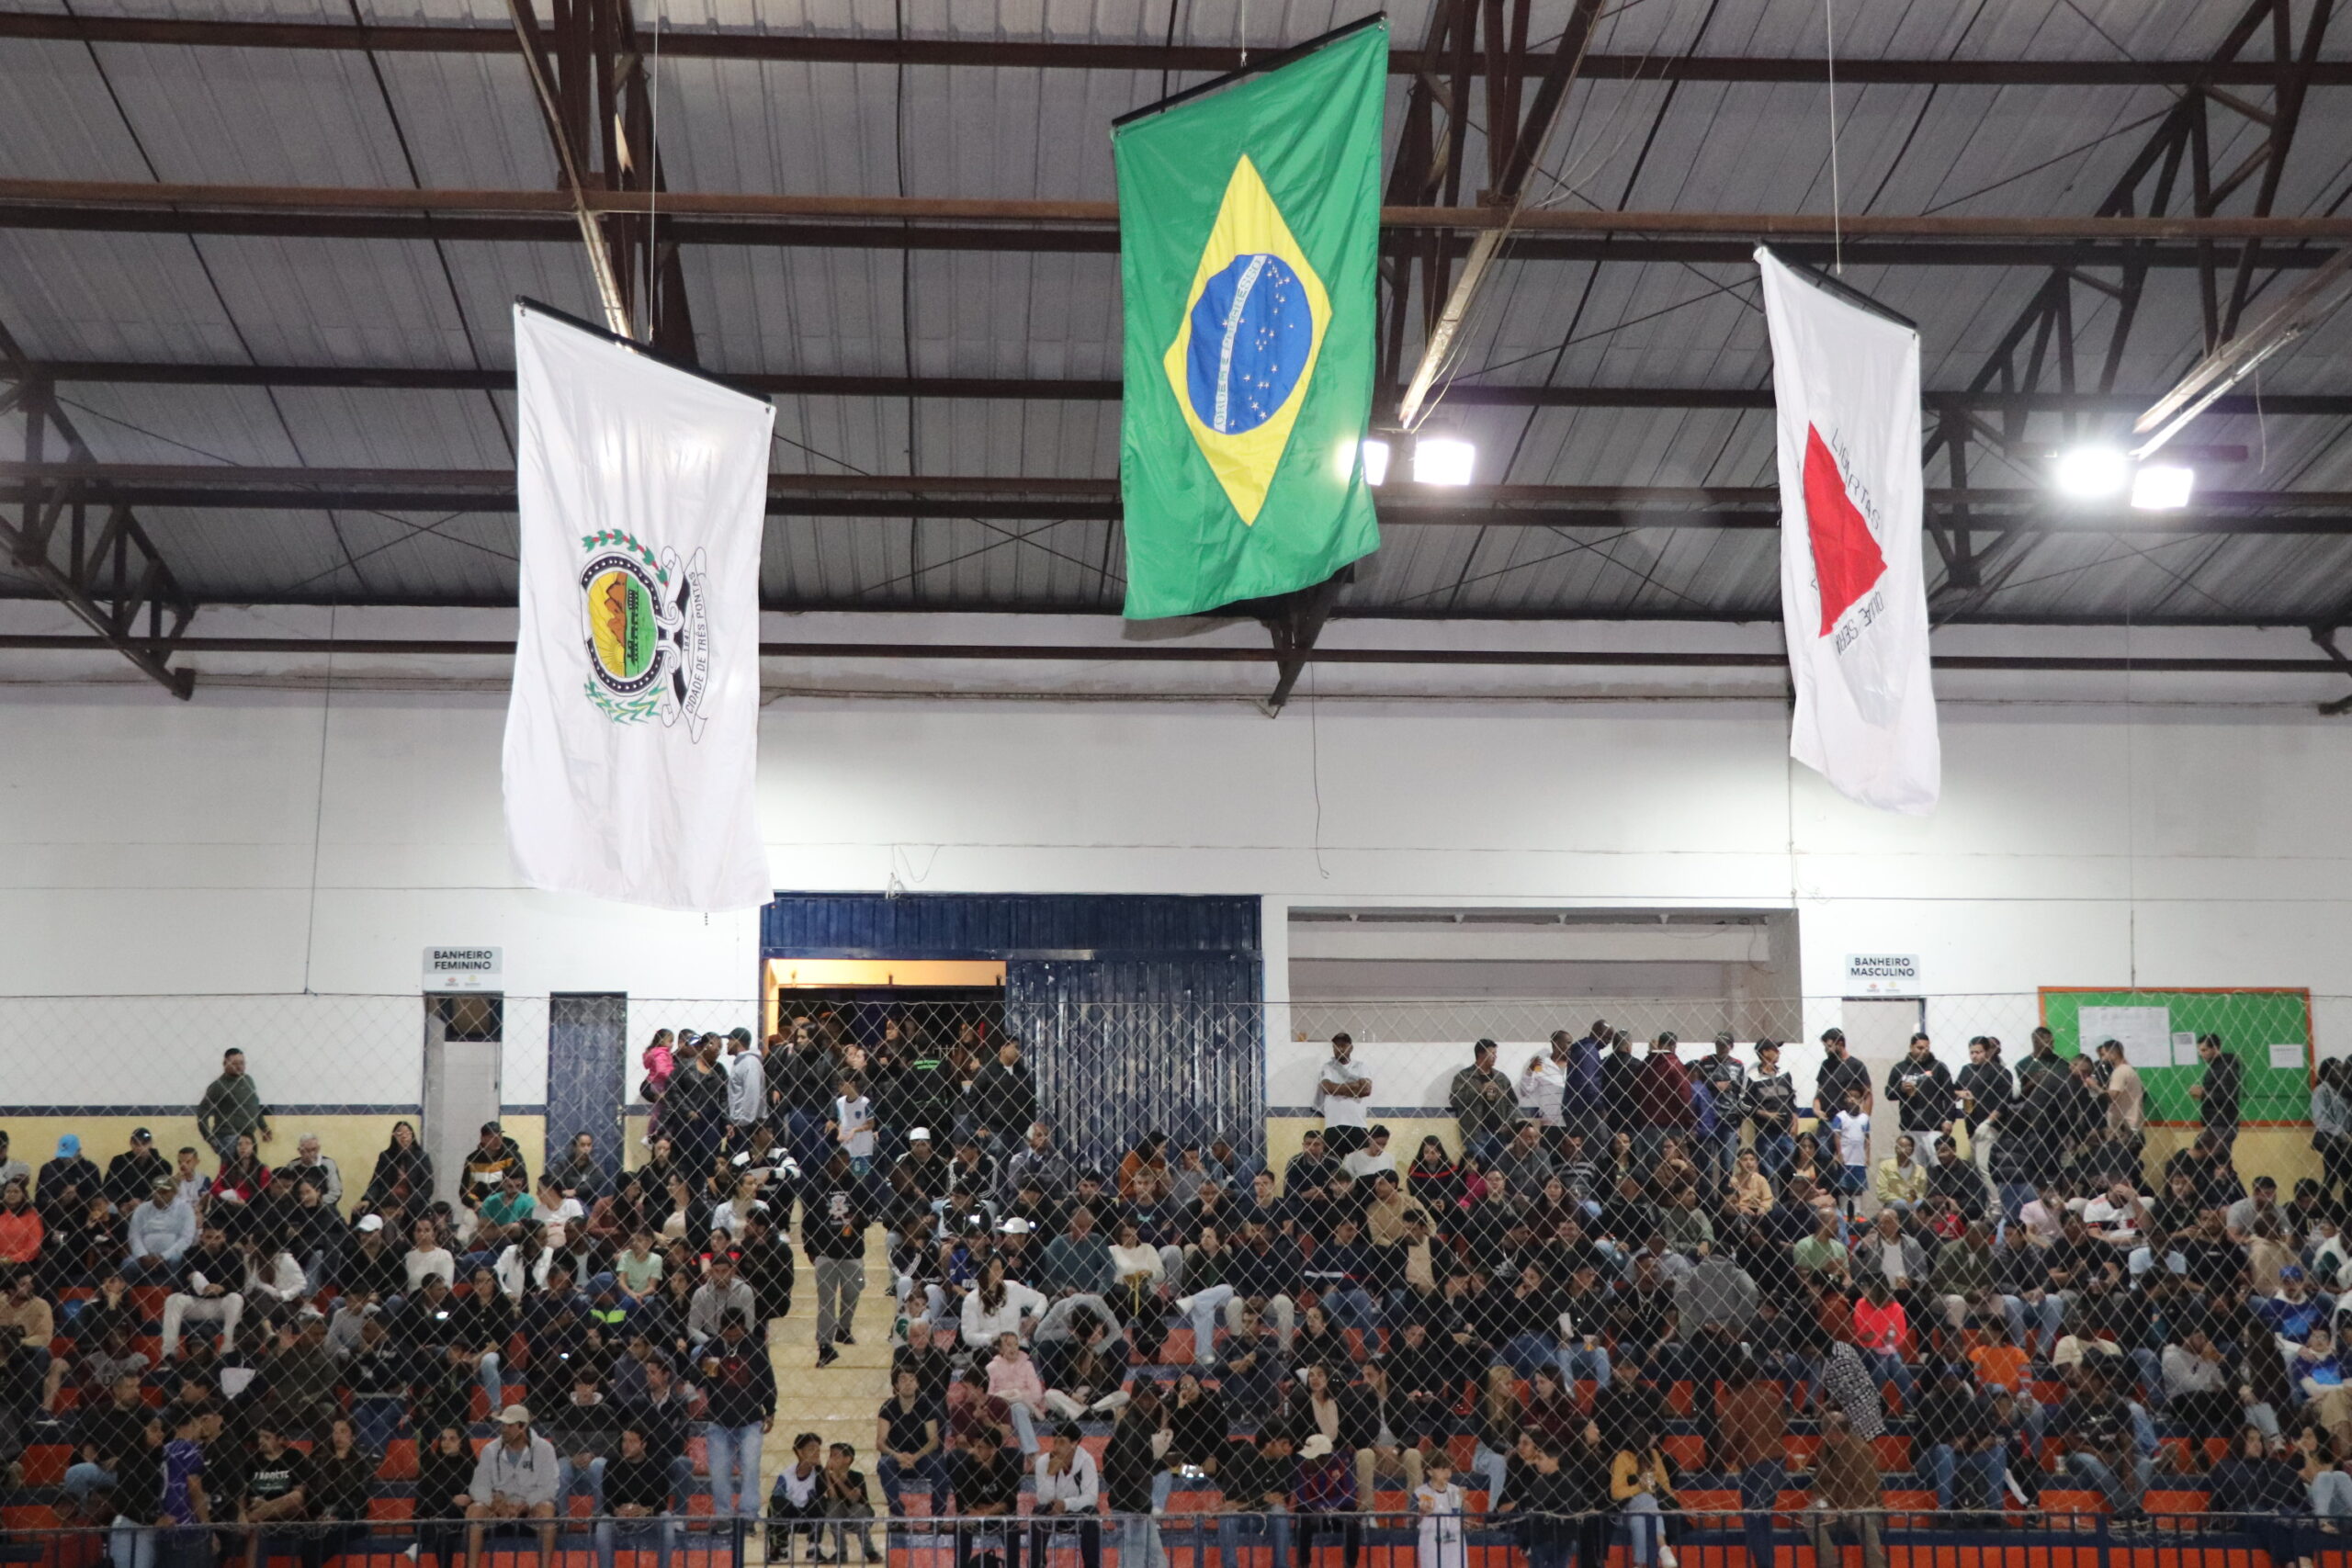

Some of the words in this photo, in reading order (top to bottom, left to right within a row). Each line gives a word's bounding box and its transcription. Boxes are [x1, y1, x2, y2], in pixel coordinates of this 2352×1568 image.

[1215, 370, 1227, 425] ORDEM
[1223, 260, 1261, 351] PROGRESSO
[688, 571, 705, 619] PONTAS
[695, 625, 707, 653] TRÊS
[695, 657, 707, 672] DE
[685, 675, 705, 715] CIDADE
[434, 950, 493, 960] BANHEIRO
[1854, 957, 1911, 967] BANHEIRO
[434, 961, 492, 970] FEMININO
[1850, 967, 1916, 977] MASCULINO
